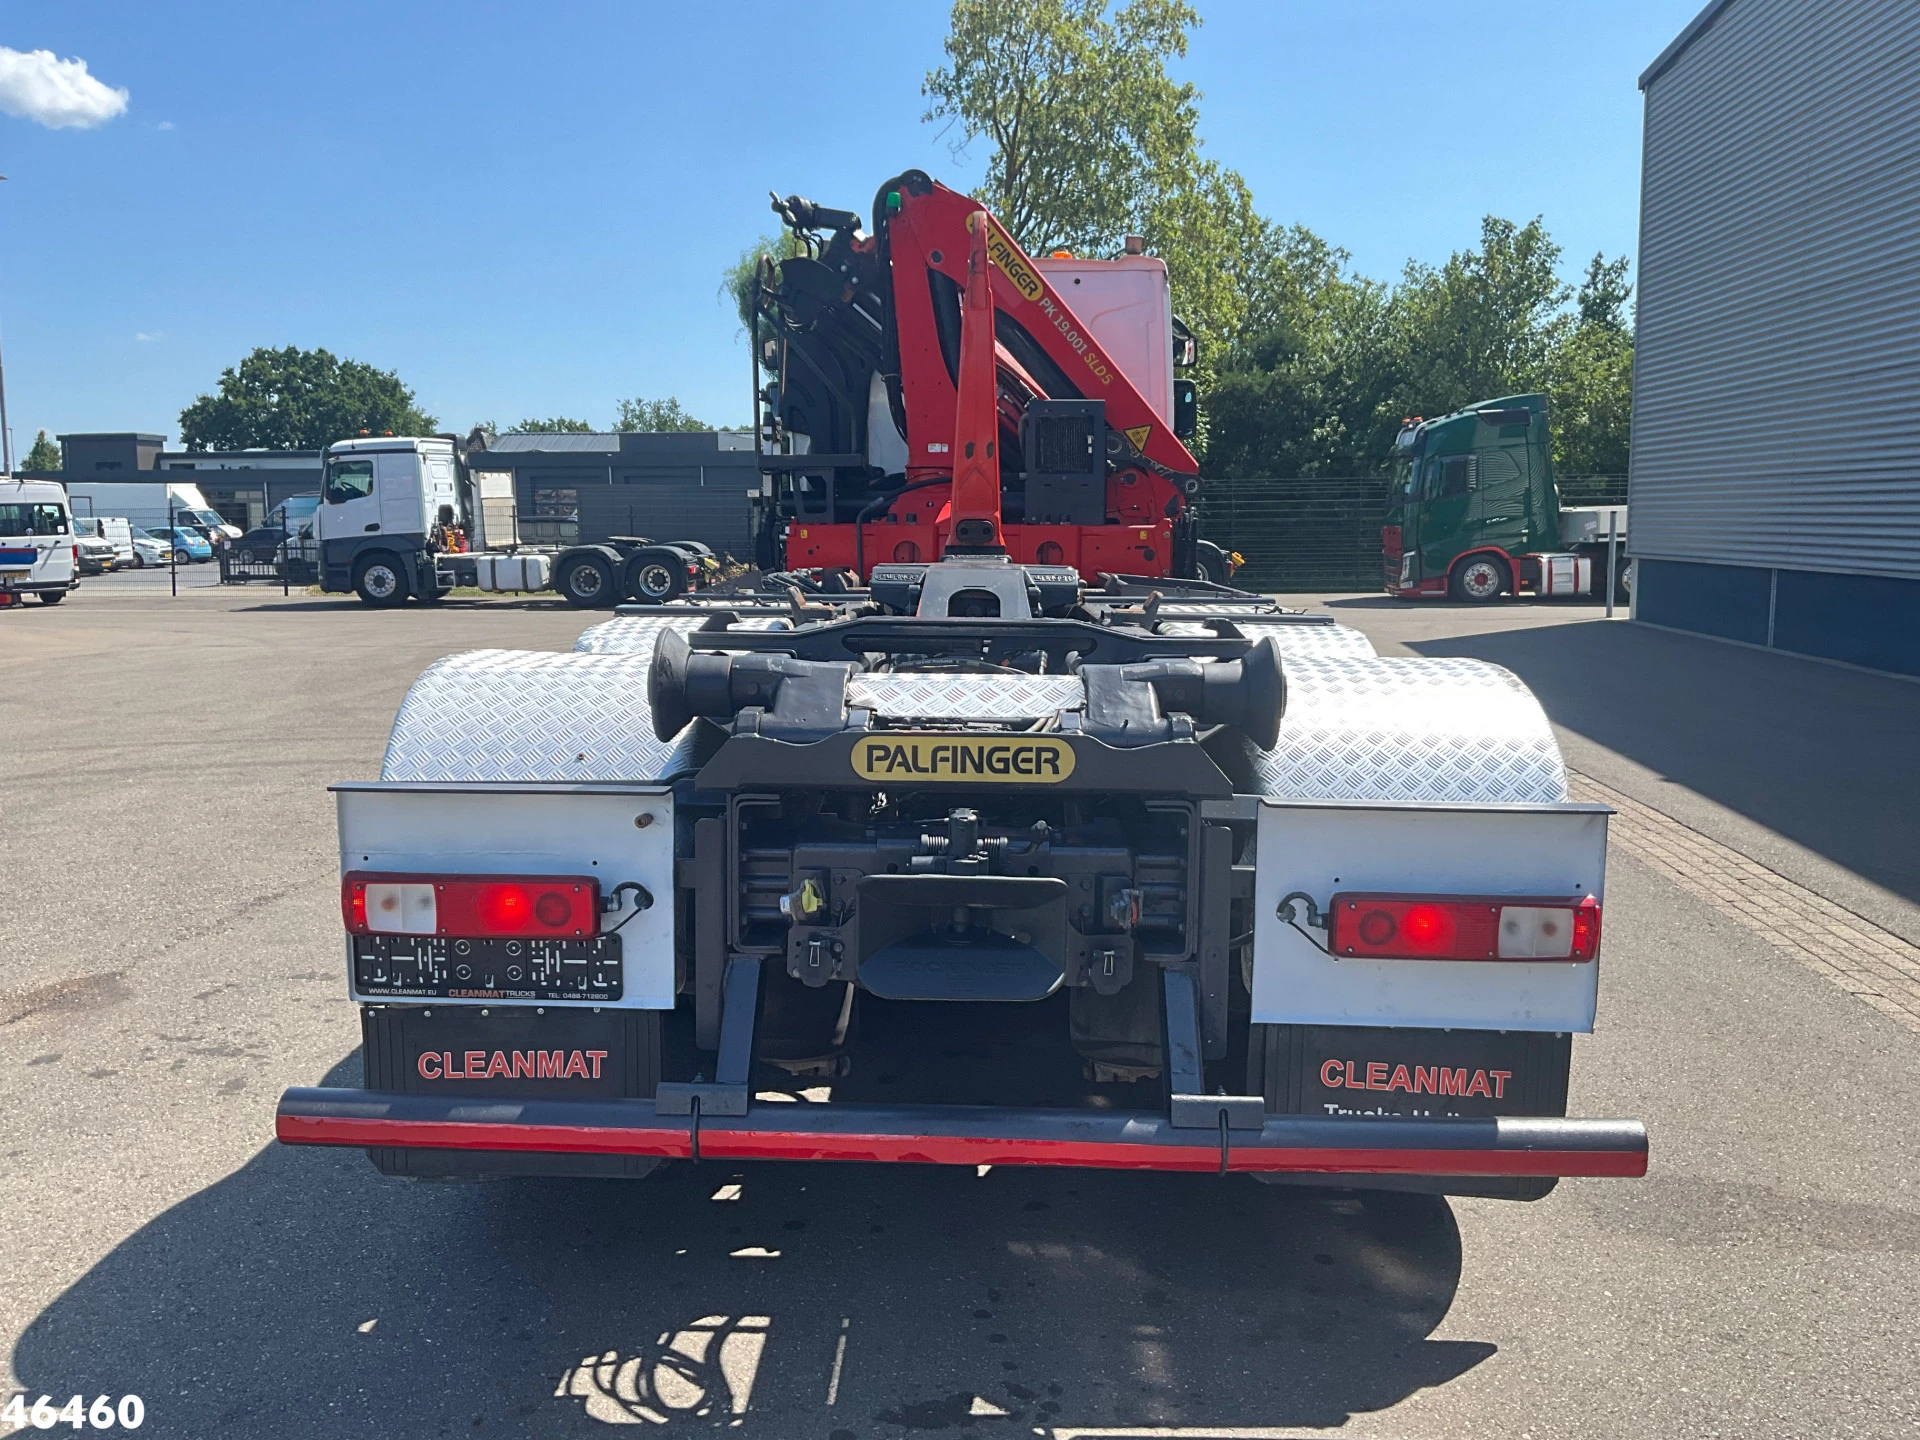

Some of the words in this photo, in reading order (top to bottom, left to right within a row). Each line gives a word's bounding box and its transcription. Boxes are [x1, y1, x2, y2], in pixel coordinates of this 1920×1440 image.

[970, 223, 1038, 297] LFINGER
[1038, 297, 1058, 318] PK
[1053, 315, 1088, 355] 19.001
[866, 744, 1060, 775] PALFINGER
[418, 1050, 608, 1079] CLEANMAT
[1320, 1059, 1512, 1098] CLEANMAT
